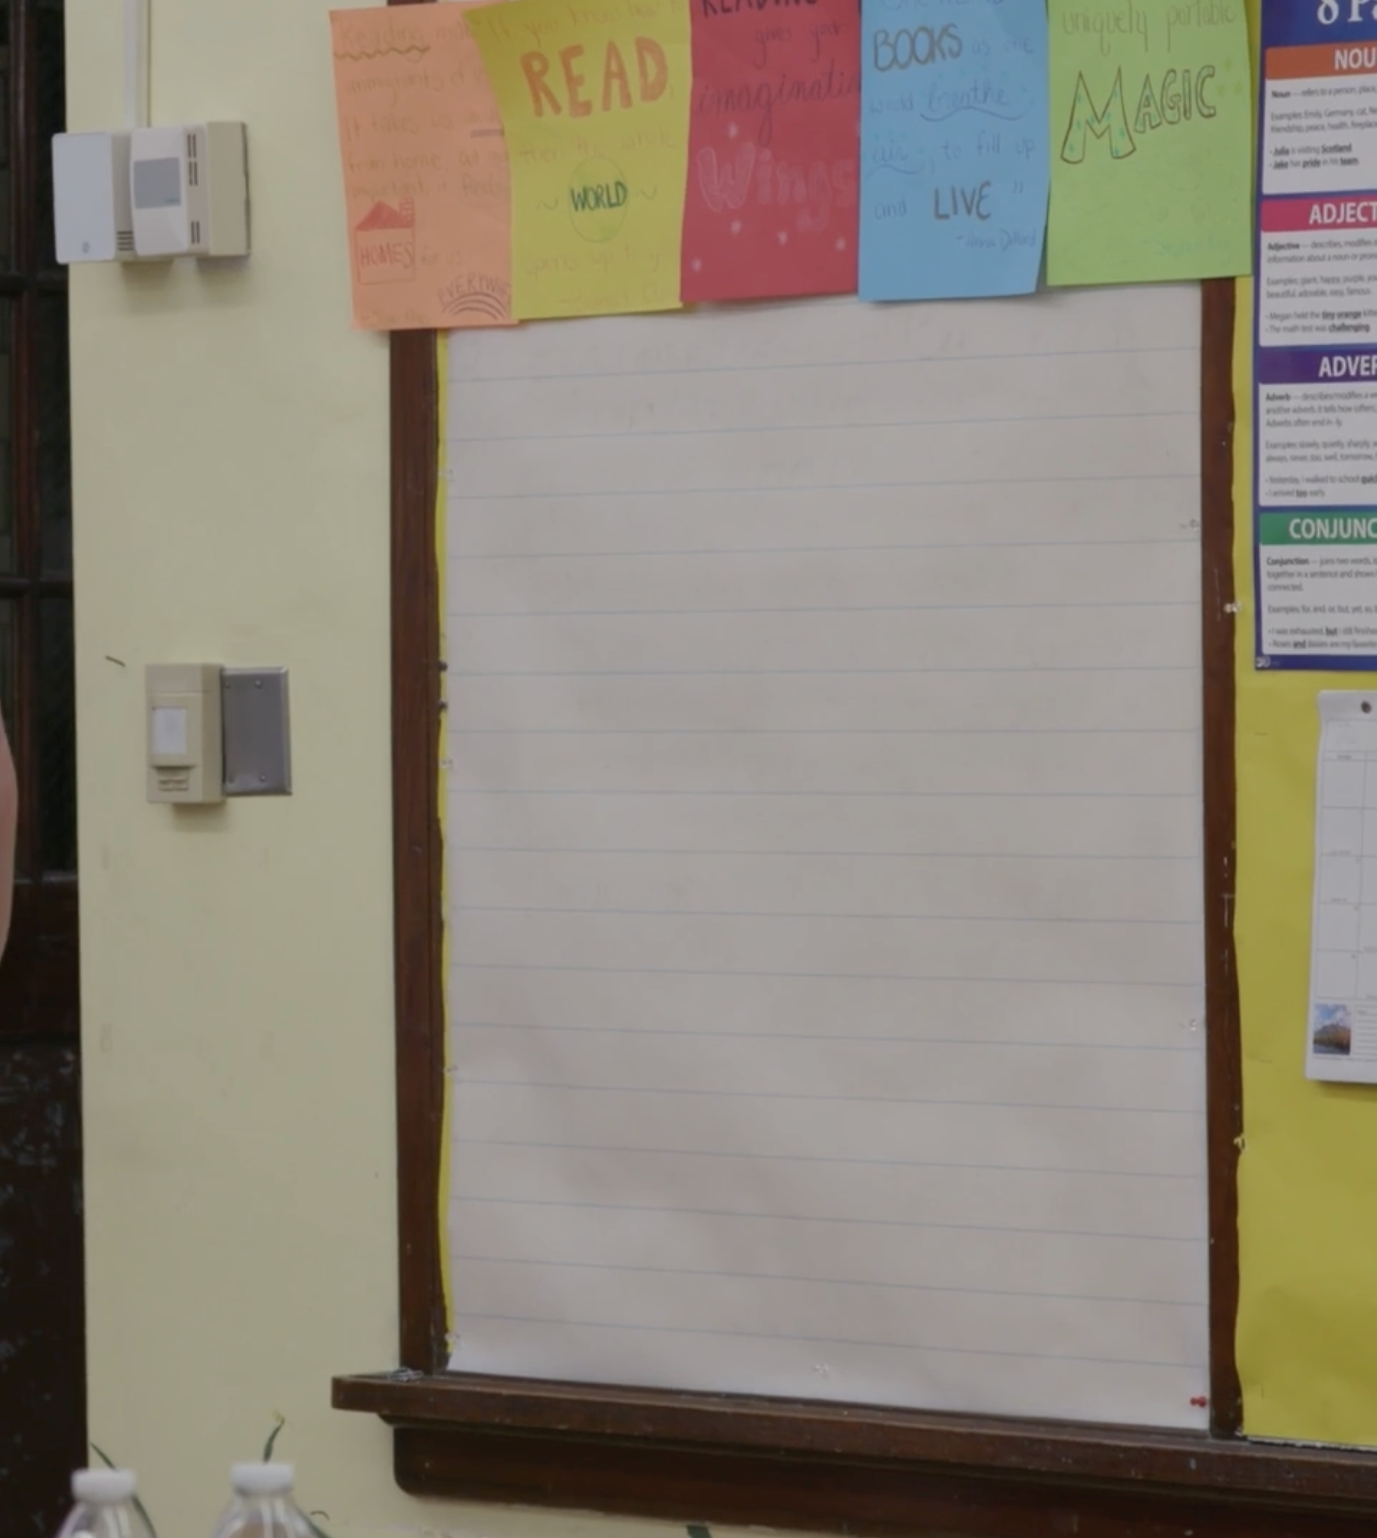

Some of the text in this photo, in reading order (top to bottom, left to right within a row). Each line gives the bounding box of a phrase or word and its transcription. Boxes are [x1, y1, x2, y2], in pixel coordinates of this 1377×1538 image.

[873, 22, 964, 73] BOOKS
[1060, 64, 1217, 165] MAGIC
[570, 180, 628, 212] WORLD
[360, 241, 414, 270] HOMES
[1266, 556, 1309, 567] Conjunction
